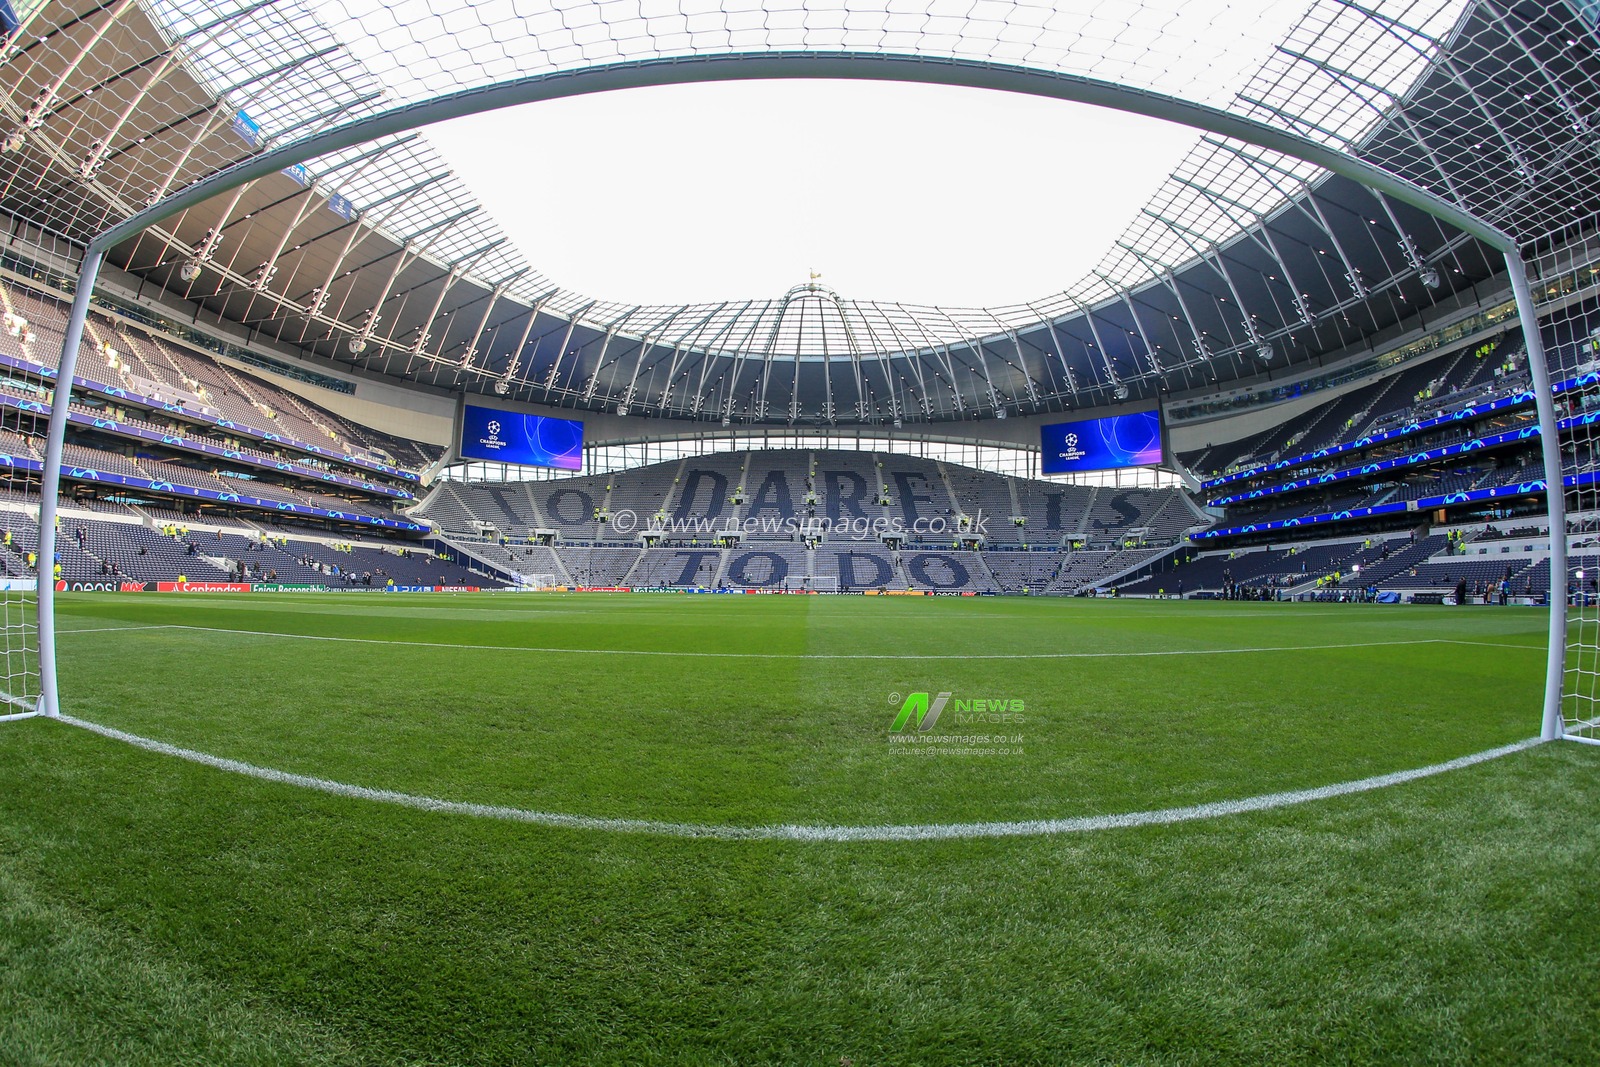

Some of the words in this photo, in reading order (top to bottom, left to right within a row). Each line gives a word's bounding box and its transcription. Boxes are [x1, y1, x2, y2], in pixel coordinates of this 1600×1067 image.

[480, 438, 507, 447] CHAMPIONS
[470, 484, 595, 526] TO
[673, 469, 933, 528] DARE
[1044, 491, 1150, 530] IS
[673, 551, 790, 587] TO
[833, 552, 971, 589] DO
[121, 582, 148, 592] MAX
[253, 584, 277, 592] Enjoy
